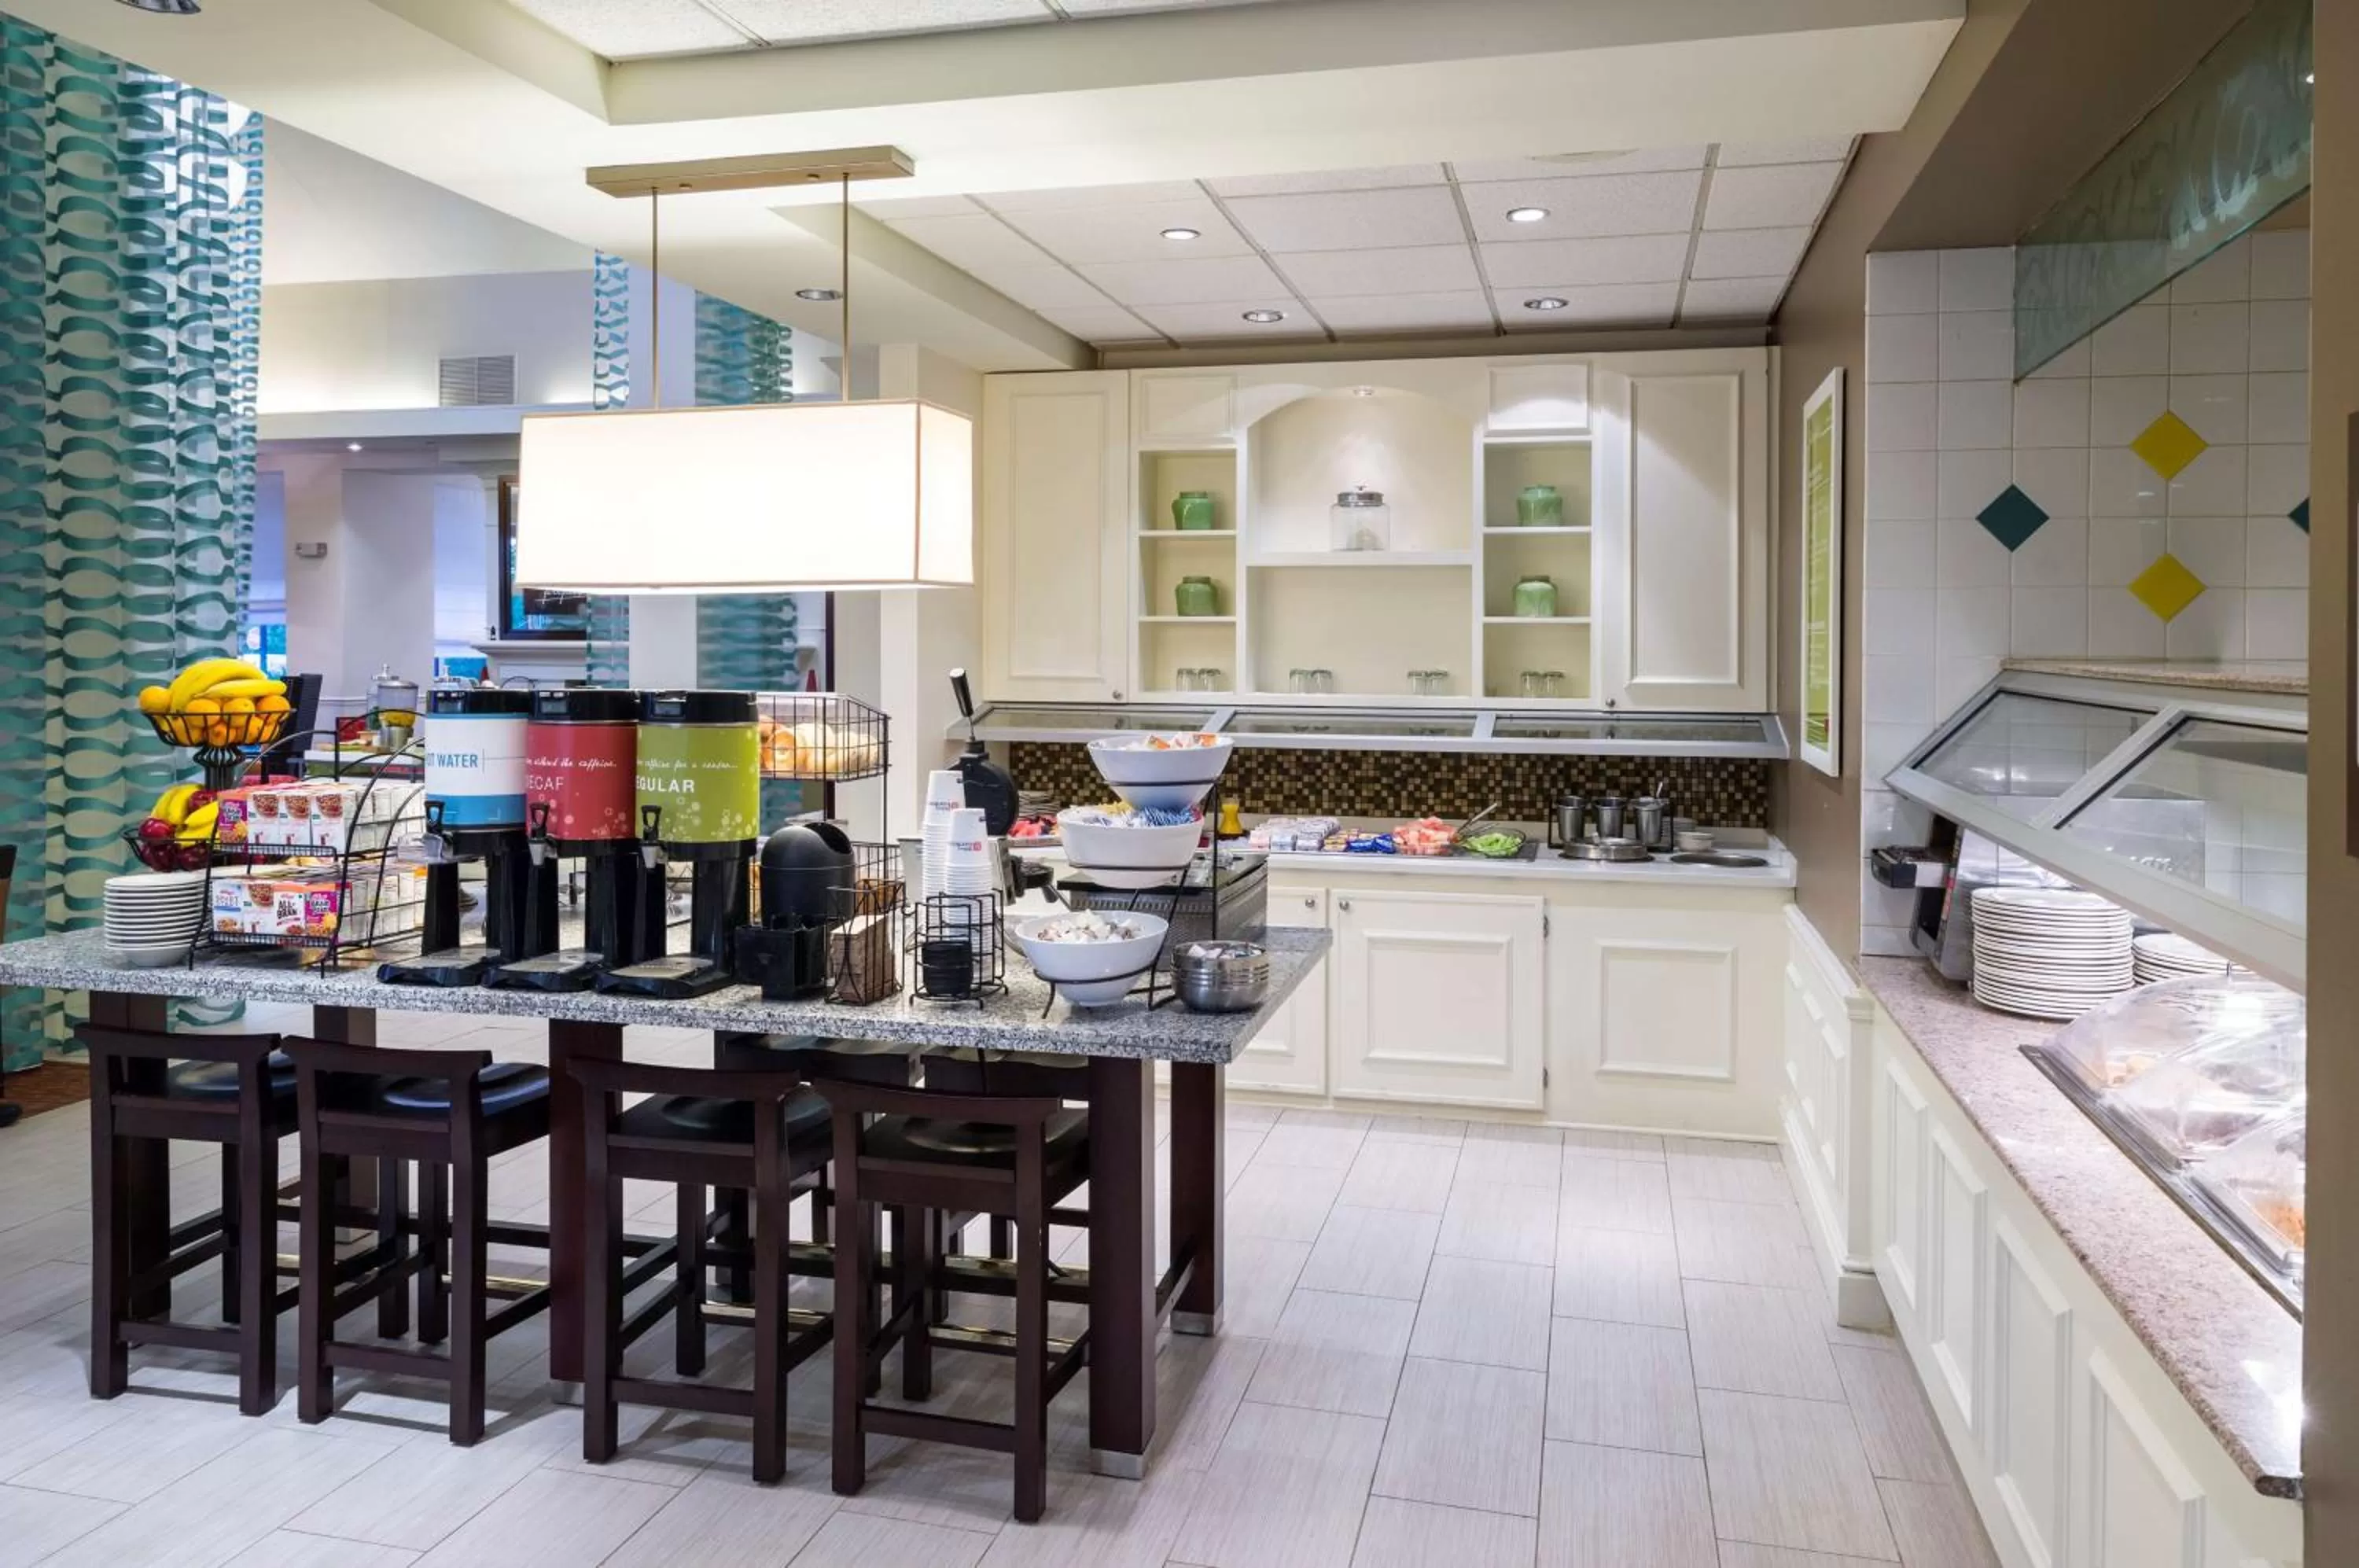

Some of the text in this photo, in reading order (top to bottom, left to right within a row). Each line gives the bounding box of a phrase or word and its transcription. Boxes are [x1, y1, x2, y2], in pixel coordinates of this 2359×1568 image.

[436, 753, 478, 767] WATER
[528, 775, 565, 791] ECAF
[635, 775, 695, 793] EGULAR
